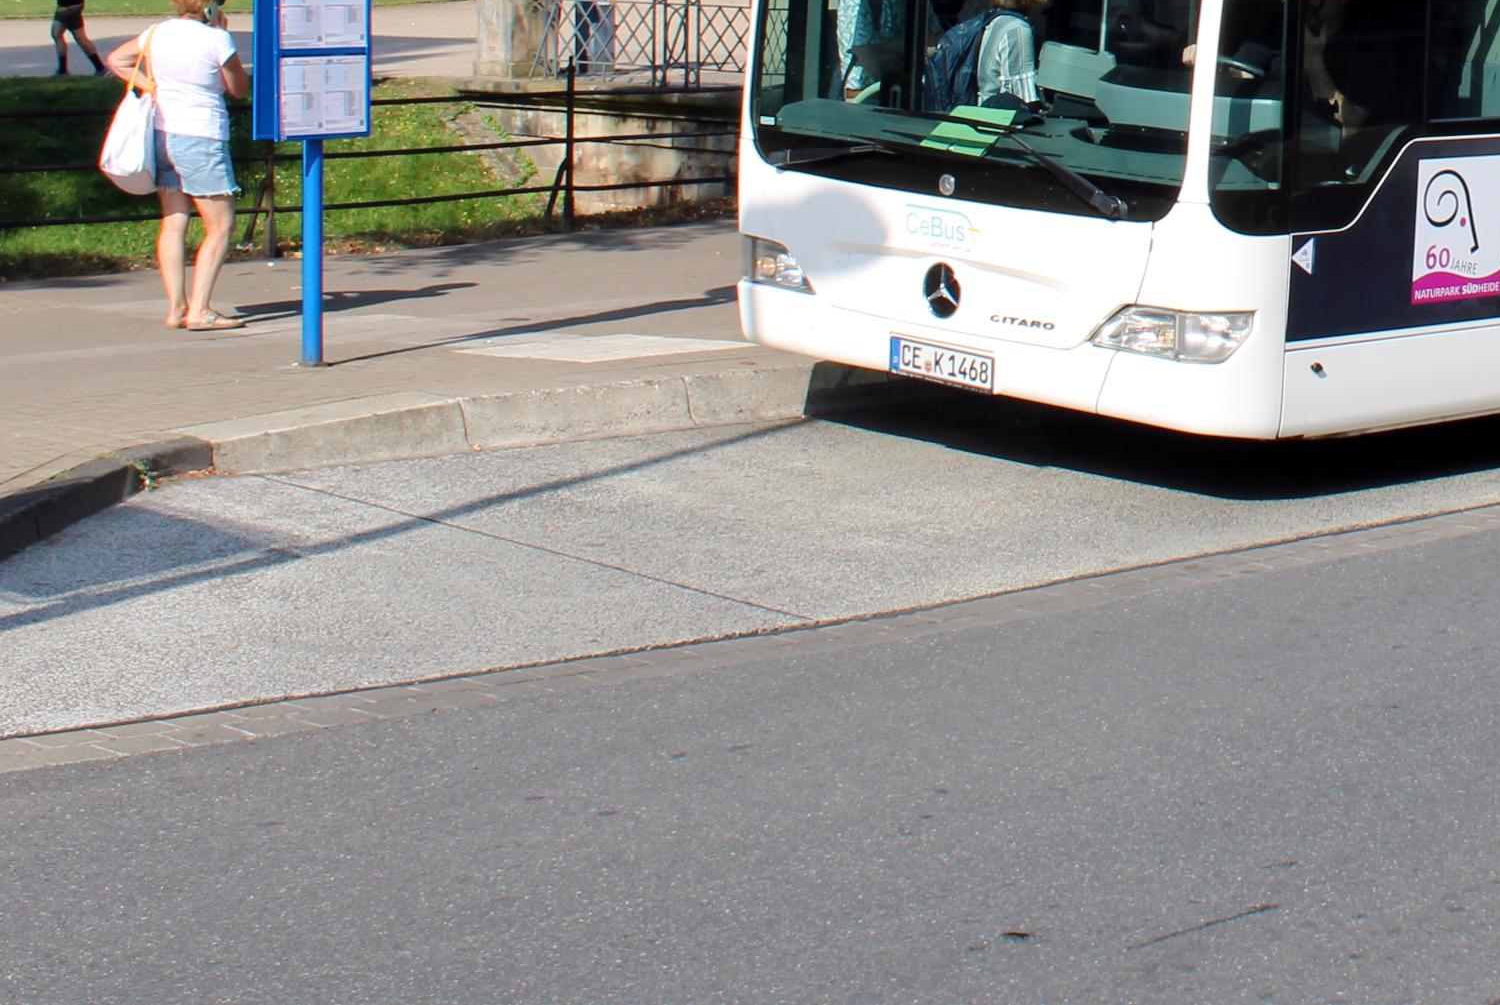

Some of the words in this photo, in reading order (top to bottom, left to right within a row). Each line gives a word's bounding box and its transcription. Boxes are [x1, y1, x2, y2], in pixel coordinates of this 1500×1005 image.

[905, 212, 966, 242] CeBus
[1426, 245, 1450, 270] 60
[1449, 258, 1478, 276] JAHRE
[1414, 283, 1461, 300] NATURPARK
[1461, 280, 1500, 295] SÜDHEIDE
[990, 313, 1056, 331] CITARO
[901, 344, 922, 371] CE
[947, 354, 990, 384] 1468
